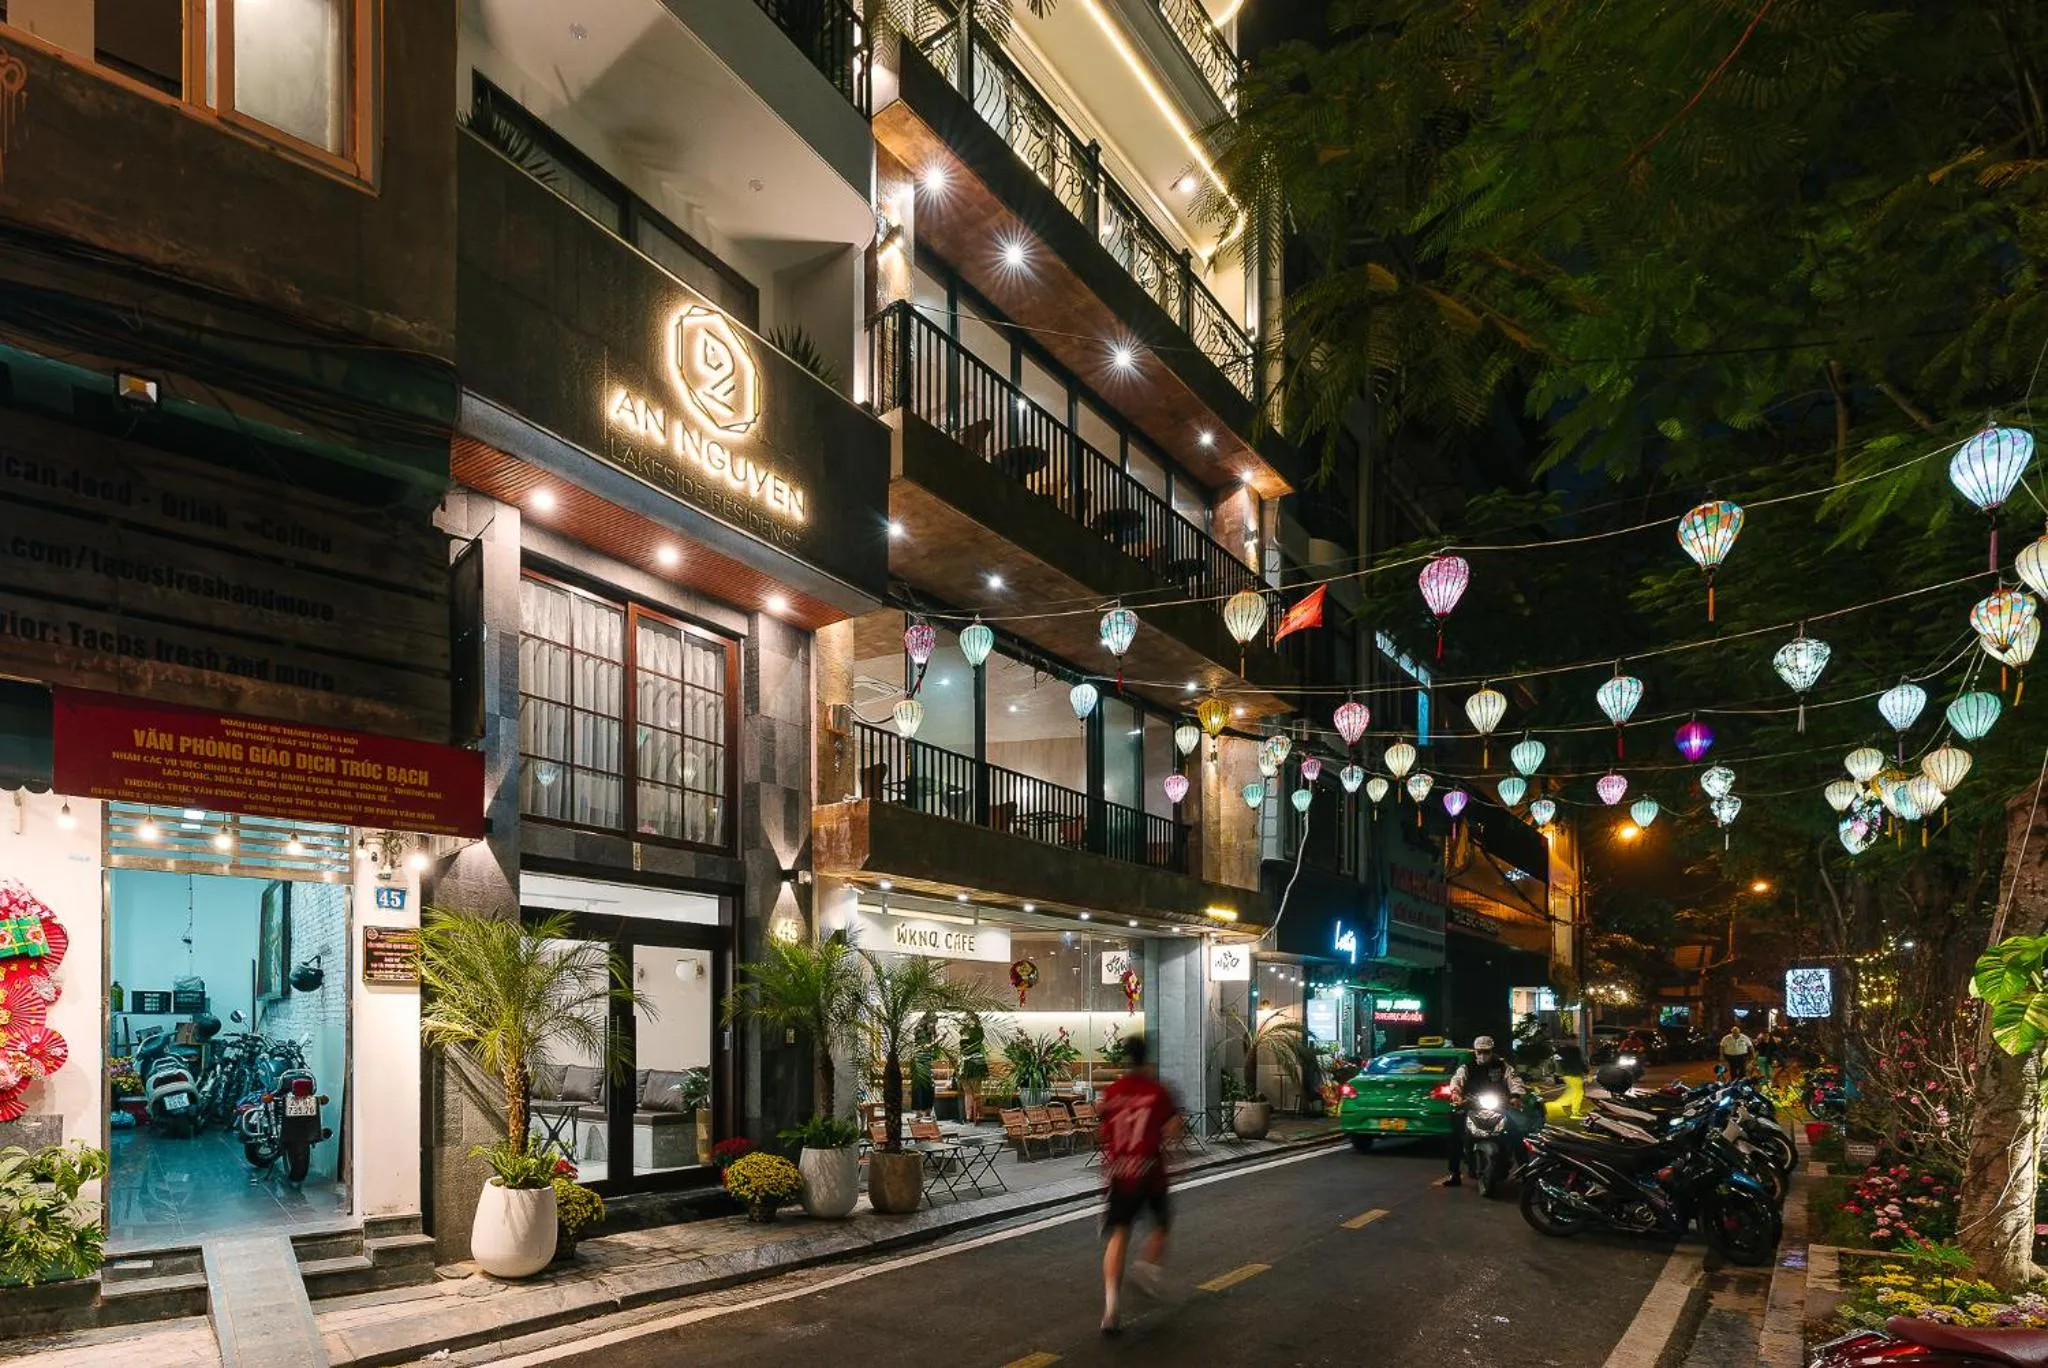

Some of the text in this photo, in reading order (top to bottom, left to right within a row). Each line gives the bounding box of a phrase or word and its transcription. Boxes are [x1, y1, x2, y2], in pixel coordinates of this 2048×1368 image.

[615, 391, 807, 518] AN NGUYEN
[610, 437, 803, 549] LAKESIDE RESIDENCE
[68, 622, 146, 659] Tacos
[155, 636, 220, 670] fresh
[226, 652, 270, 681] and
[133, 727, 174, 751] VĂN
[179, 735, 244, 761] PHÒNG
[295, 752, 337, 774] DỊCH
[340, 759, 383, 780] TRÚC
[386, 766, 430, 787] BẠCH
[378, 890, 401, 907] 45
[780, 921, 798, 940] 45
